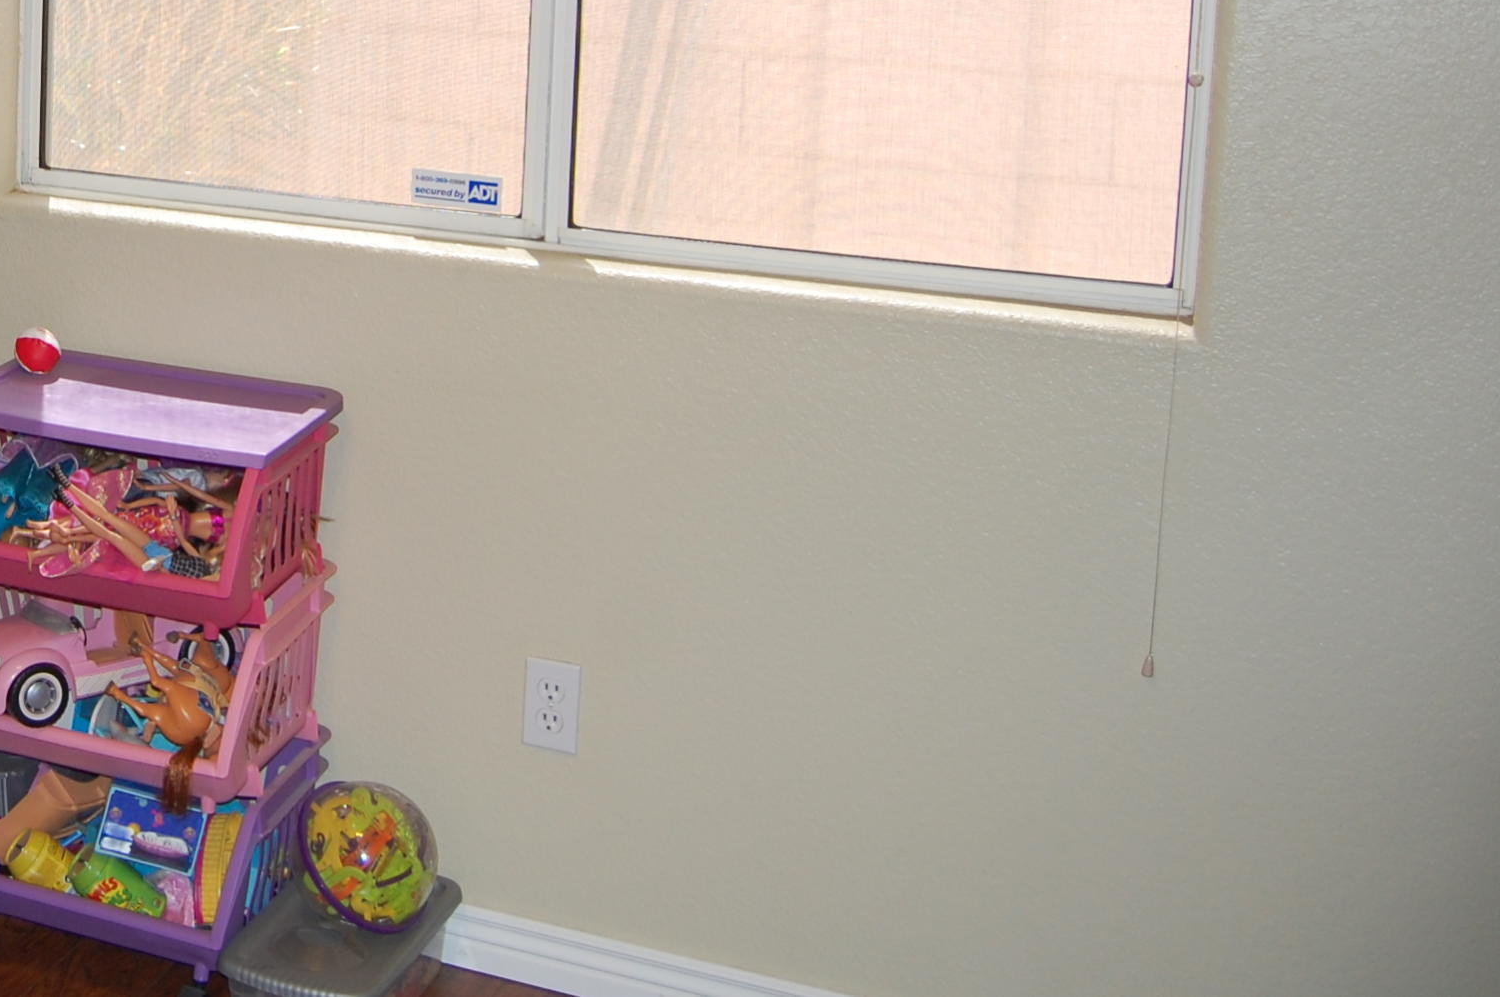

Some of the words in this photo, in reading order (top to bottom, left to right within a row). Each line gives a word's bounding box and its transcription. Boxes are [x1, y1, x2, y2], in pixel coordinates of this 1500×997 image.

[414, 186, 453, 198] secured
[453, 189, 467, 200] by
[467, 183, 497, 203] ADT
